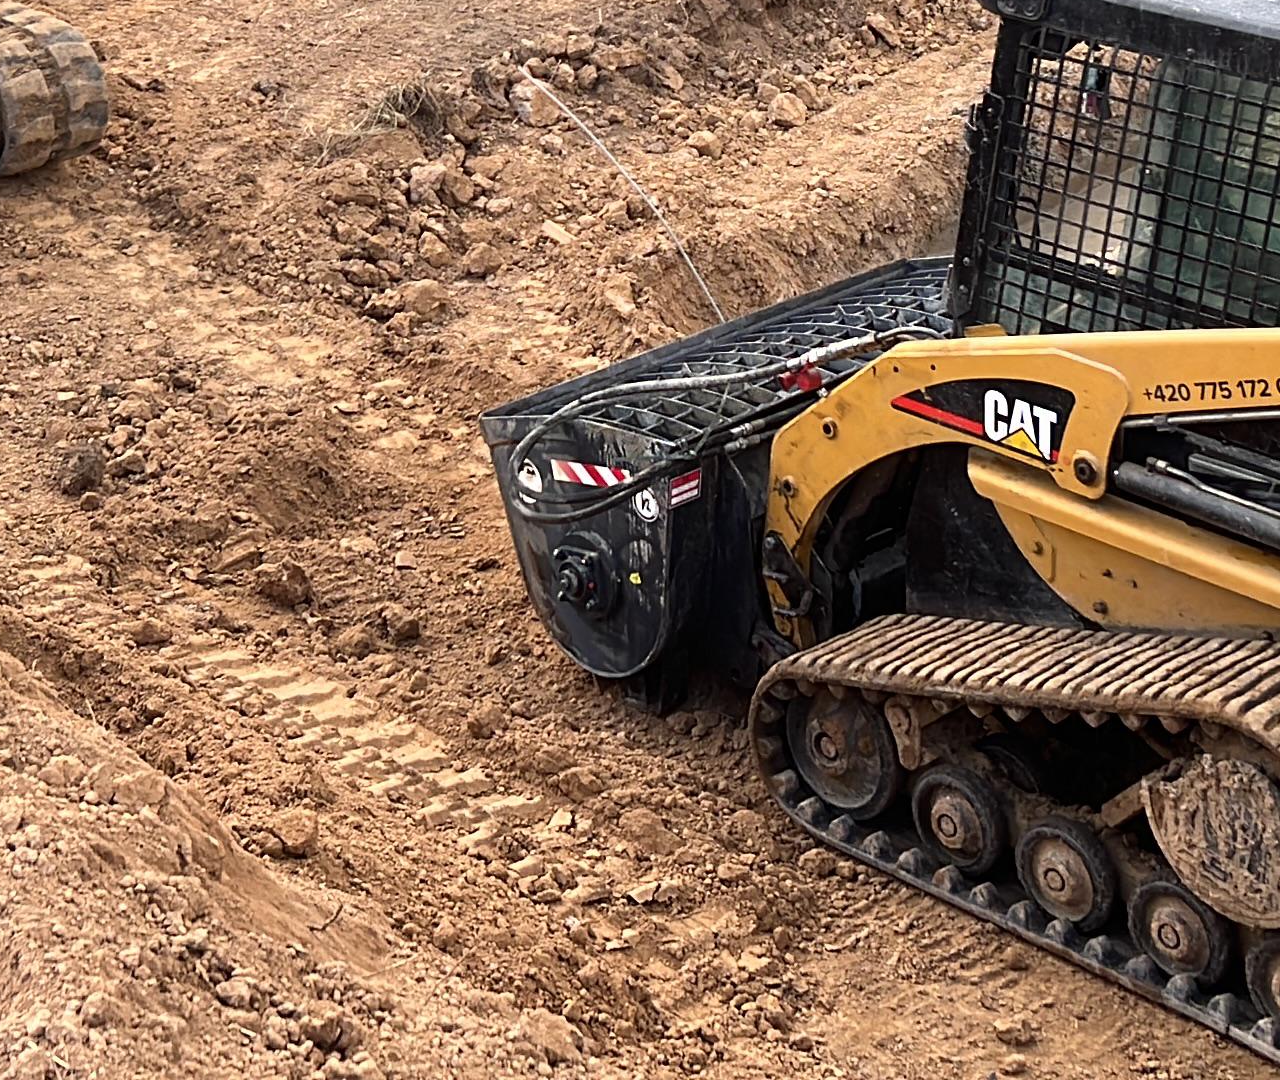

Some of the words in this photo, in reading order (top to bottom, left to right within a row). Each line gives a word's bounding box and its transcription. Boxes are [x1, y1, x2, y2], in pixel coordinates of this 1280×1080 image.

[1143, 383, 1191, 402] +420
[1194, 381, 1233, 401] 775
[1236, 378, 1272, 398] 172
[984, 389, 1058, 461] CAT
